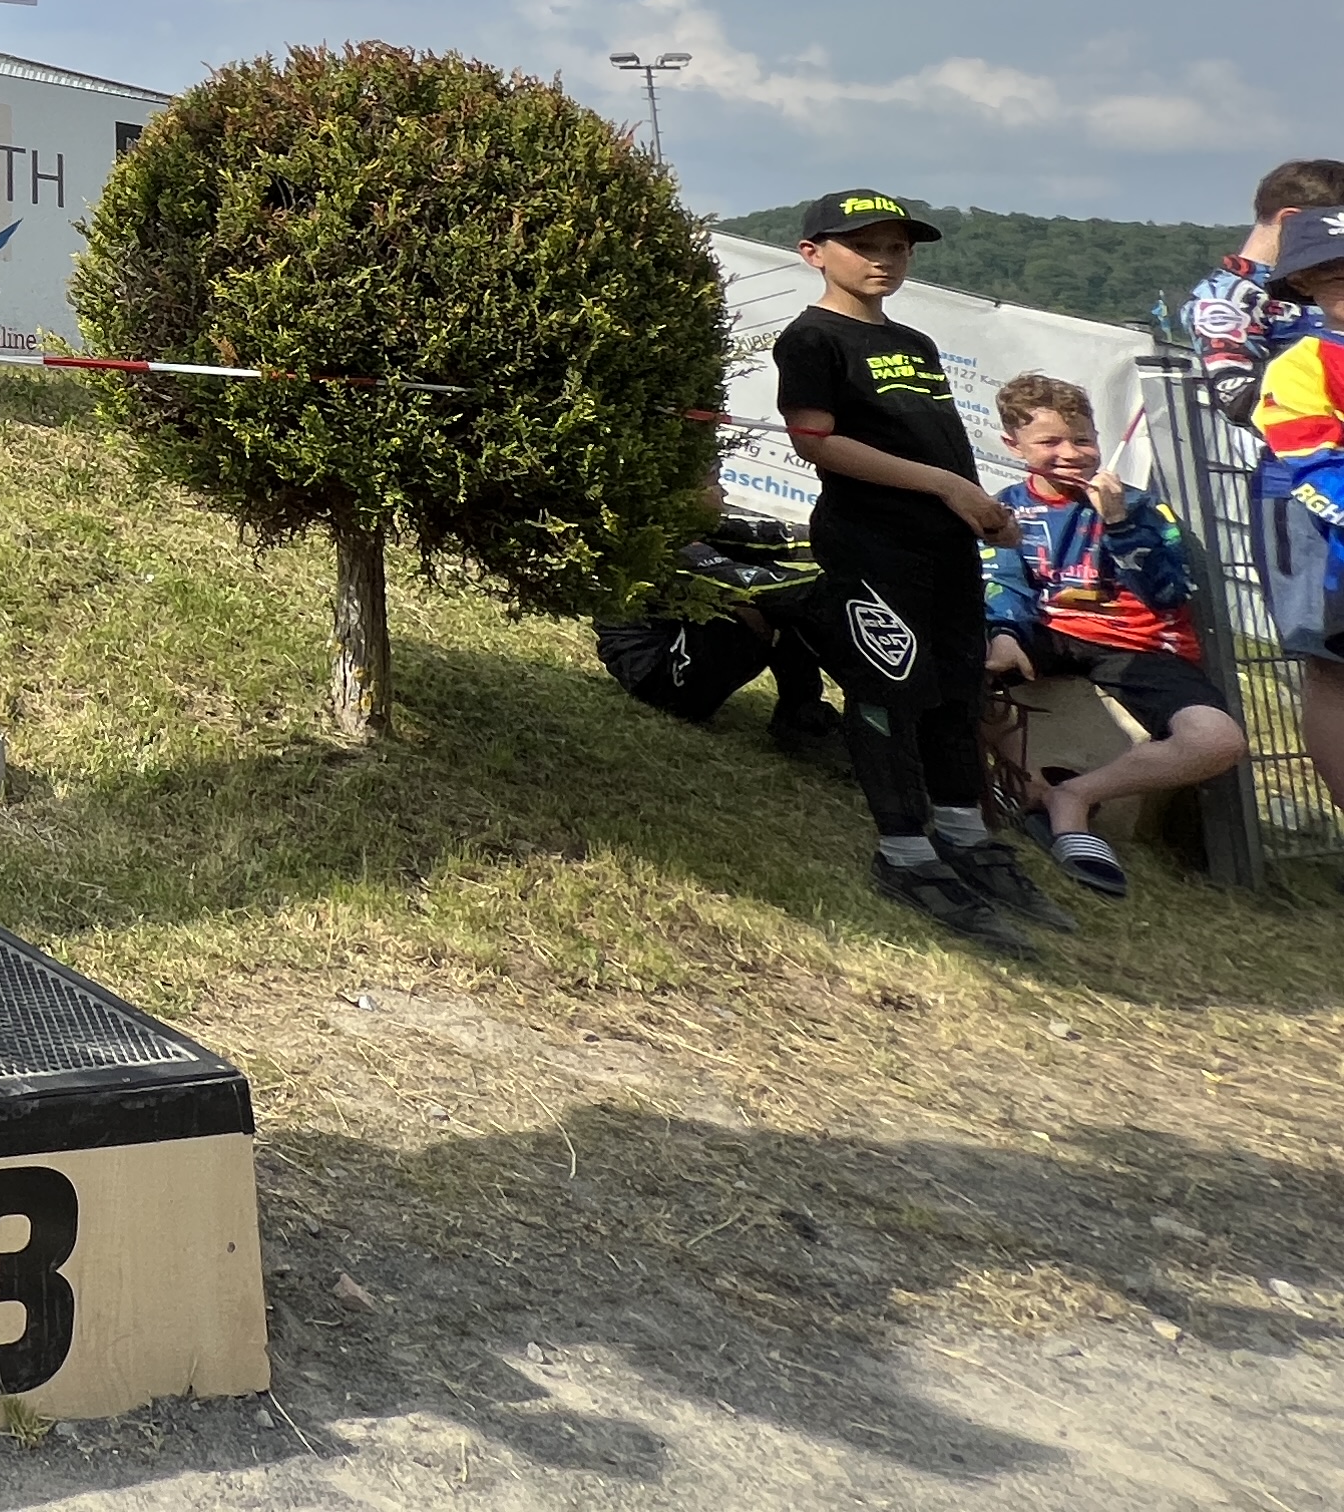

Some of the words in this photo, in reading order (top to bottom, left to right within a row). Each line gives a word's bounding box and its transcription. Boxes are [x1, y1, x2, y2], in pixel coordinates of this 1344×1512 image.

[840, 197, 906, 217] faith
[940, 351, 978, 368] assel
[953, 380, 974, 393] 1-0
[956, 399, 990, 415] ulda
[723, 468, 818, 507] aschine
